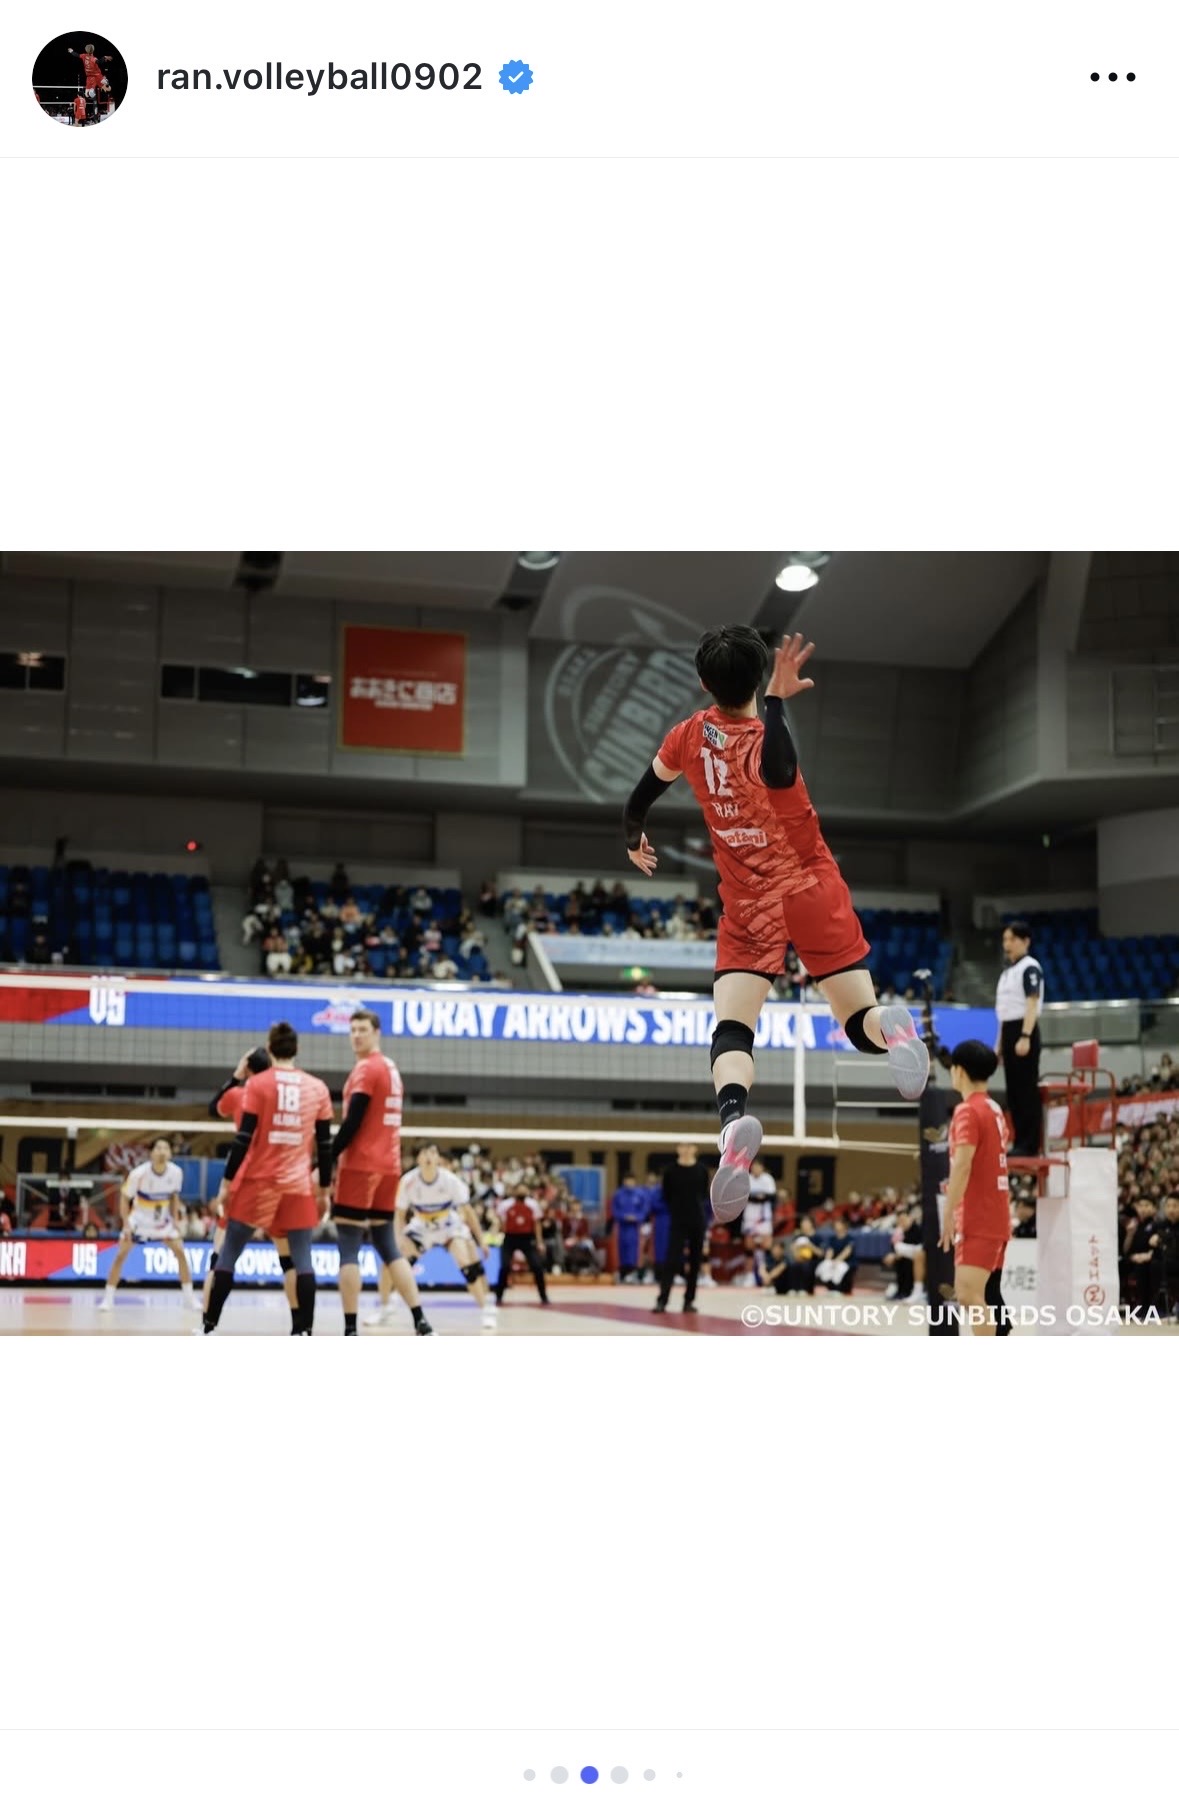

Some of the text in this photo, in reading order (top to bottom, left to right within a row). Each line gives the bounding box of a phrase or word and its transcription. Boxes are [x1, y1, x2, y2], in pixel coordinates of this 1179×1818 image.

[583, 650, 704, 794] SUNBIRD
[700, 746, 733, 797] 12
[391, 989, 497, 1037] TORAY
[502, 993, 648, 1043] ARROWS
[651, 998, 817, 1049] SHIOKA
[277, 1084, 300, 1112] 18
